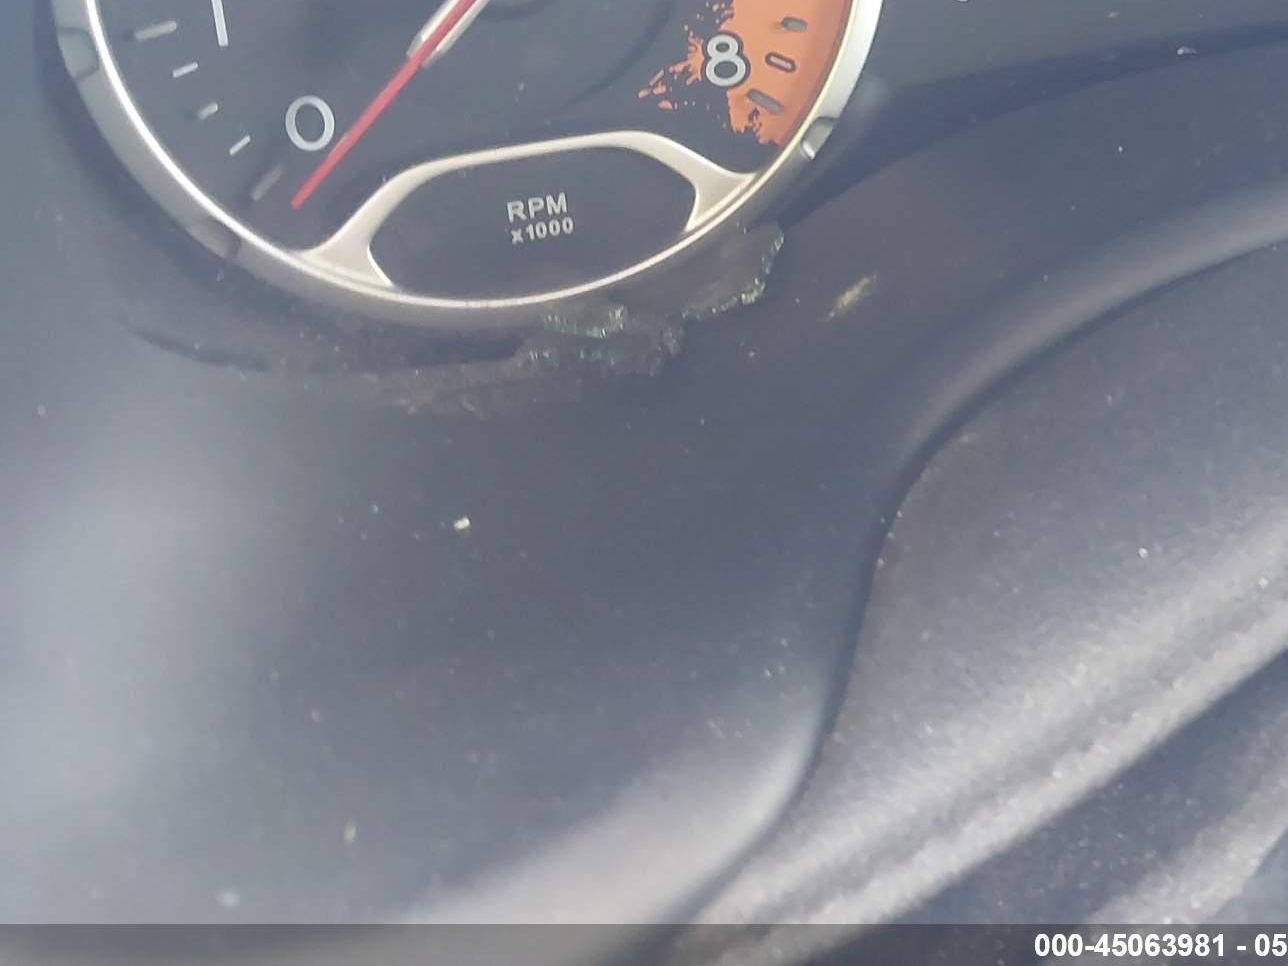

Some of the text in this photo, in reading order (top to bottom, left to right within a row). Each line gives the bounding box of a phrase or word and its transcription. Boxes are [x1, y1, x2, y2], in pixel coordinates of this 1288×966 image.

[703, 34, 748, 88] 8
[284, 94, 336, 151] 0
[505, 192, 569, 226] RPM
